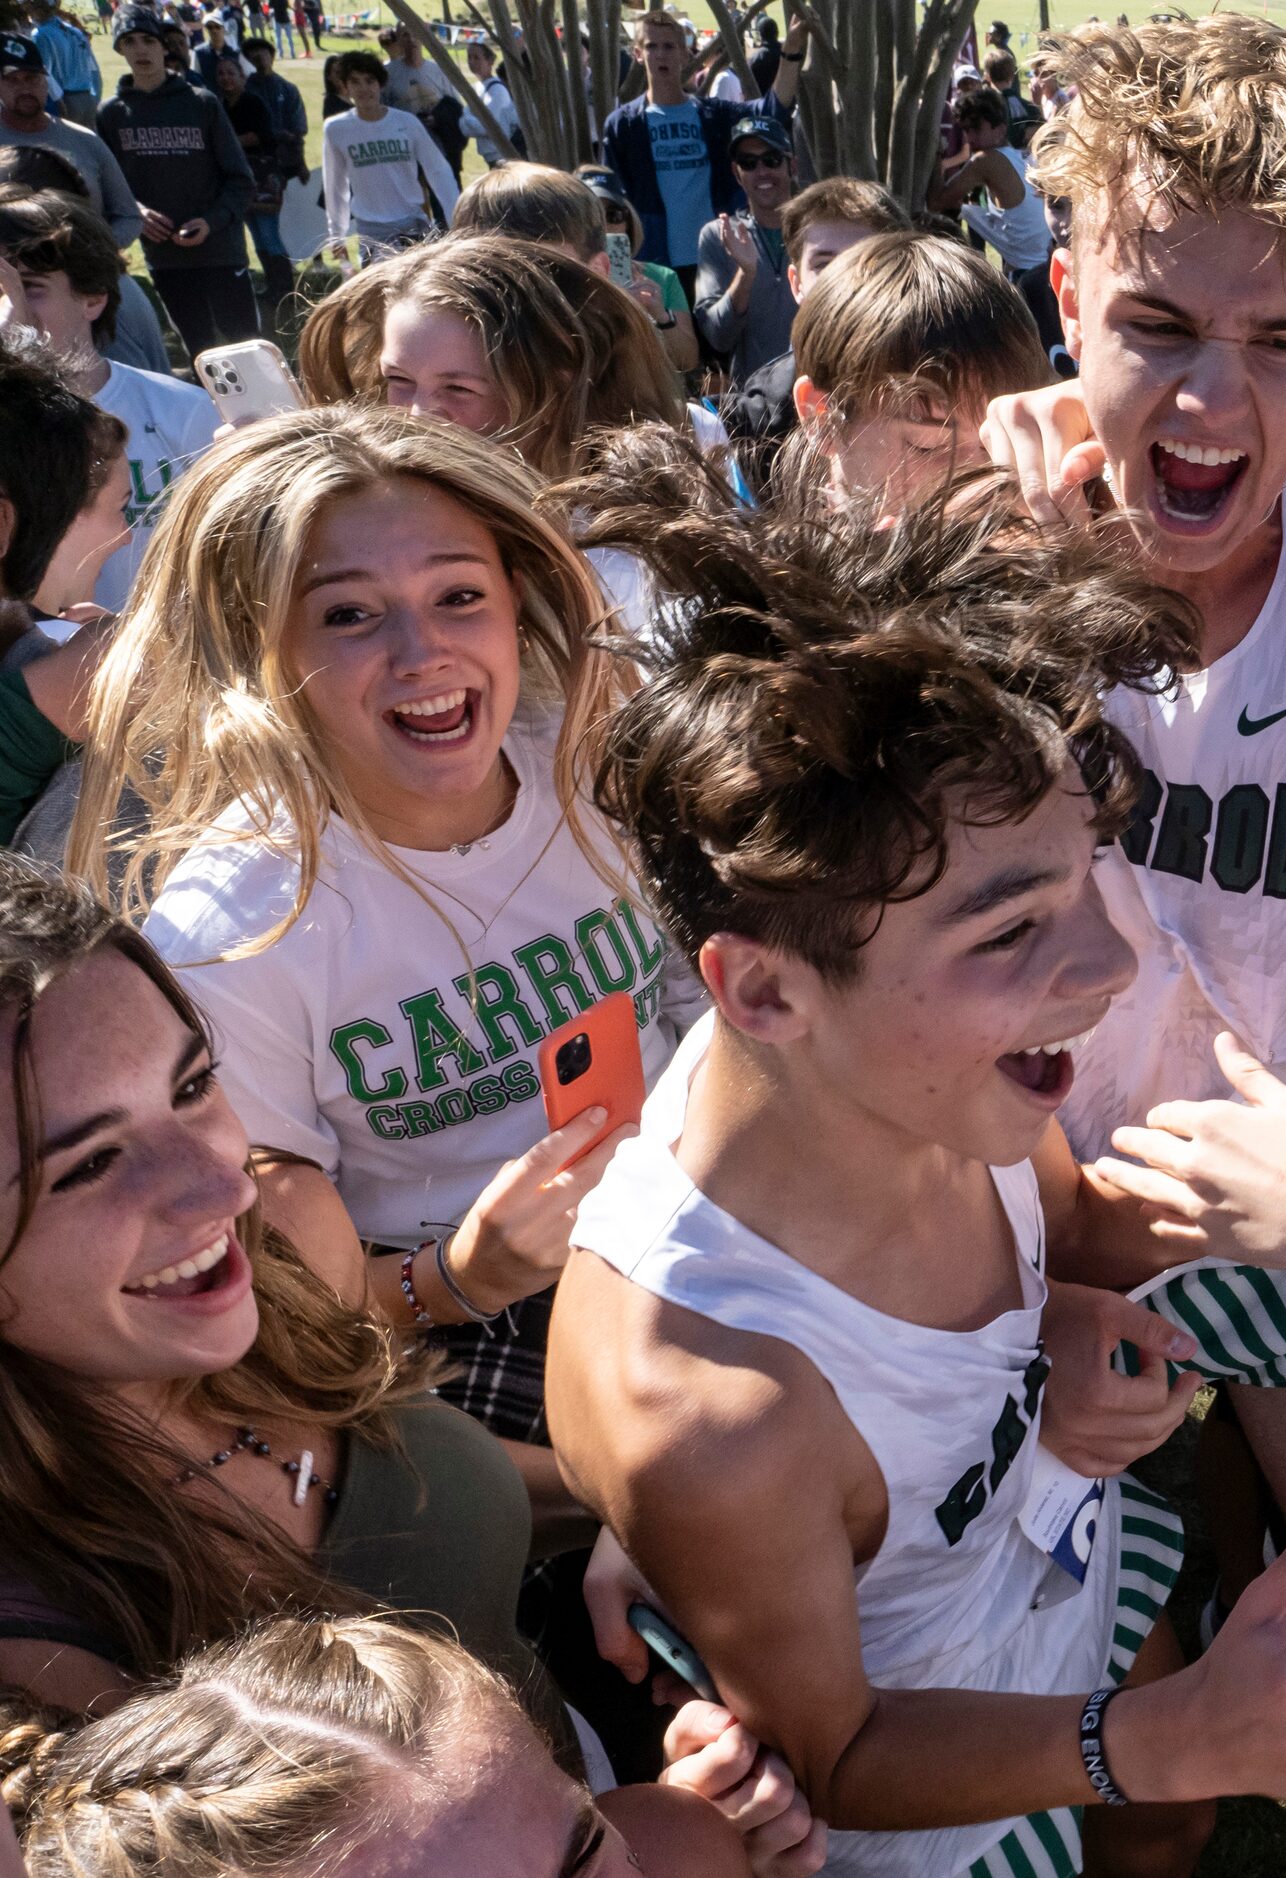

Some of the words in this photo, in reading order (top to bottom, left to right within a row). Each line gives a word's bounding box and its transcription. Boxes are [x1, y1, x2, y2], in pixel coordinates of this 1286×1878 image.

[119, 127, 205, 151] ALABAMA
[329, 897, 669, 1104] CARROL
[366, 1060, 541, 1140] CROSS
[1081, 1687, 1110, 1731] BIG
